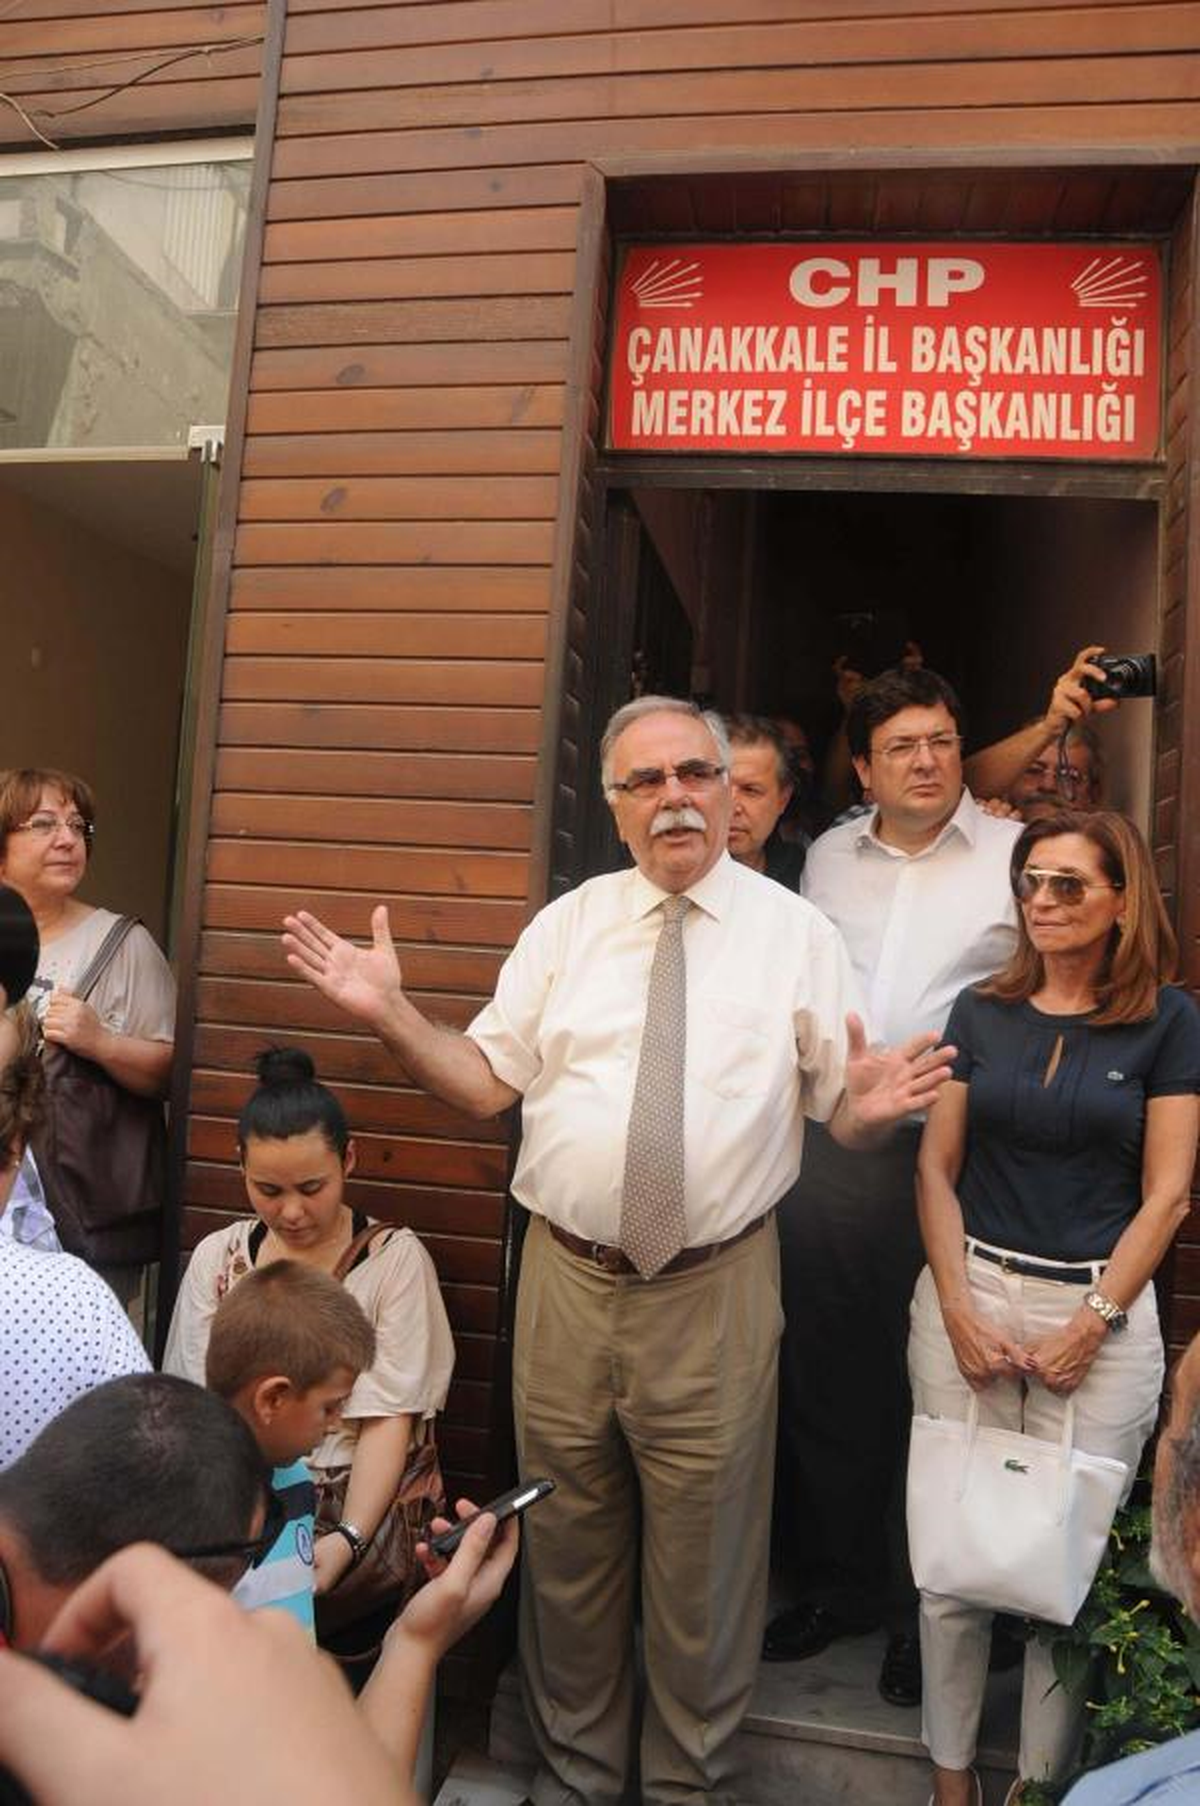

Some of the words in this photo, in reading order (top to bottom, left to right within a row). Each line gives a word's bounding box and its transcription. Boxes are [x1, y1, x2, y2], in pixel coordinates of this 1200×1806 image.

[789, 258, 986, 308] CHP
[627, 326, 849, 386] ÇANAKKALE
[863, 315, 897, 374] İL
[911, 316, 1145, 386] BAŞKANLIĞI
[631, 389, 787, 437] MERKEZ
[801, 379, 887, 448] İLÇE
[901, 382, 1134, 450] BAŞKANLIĞI
